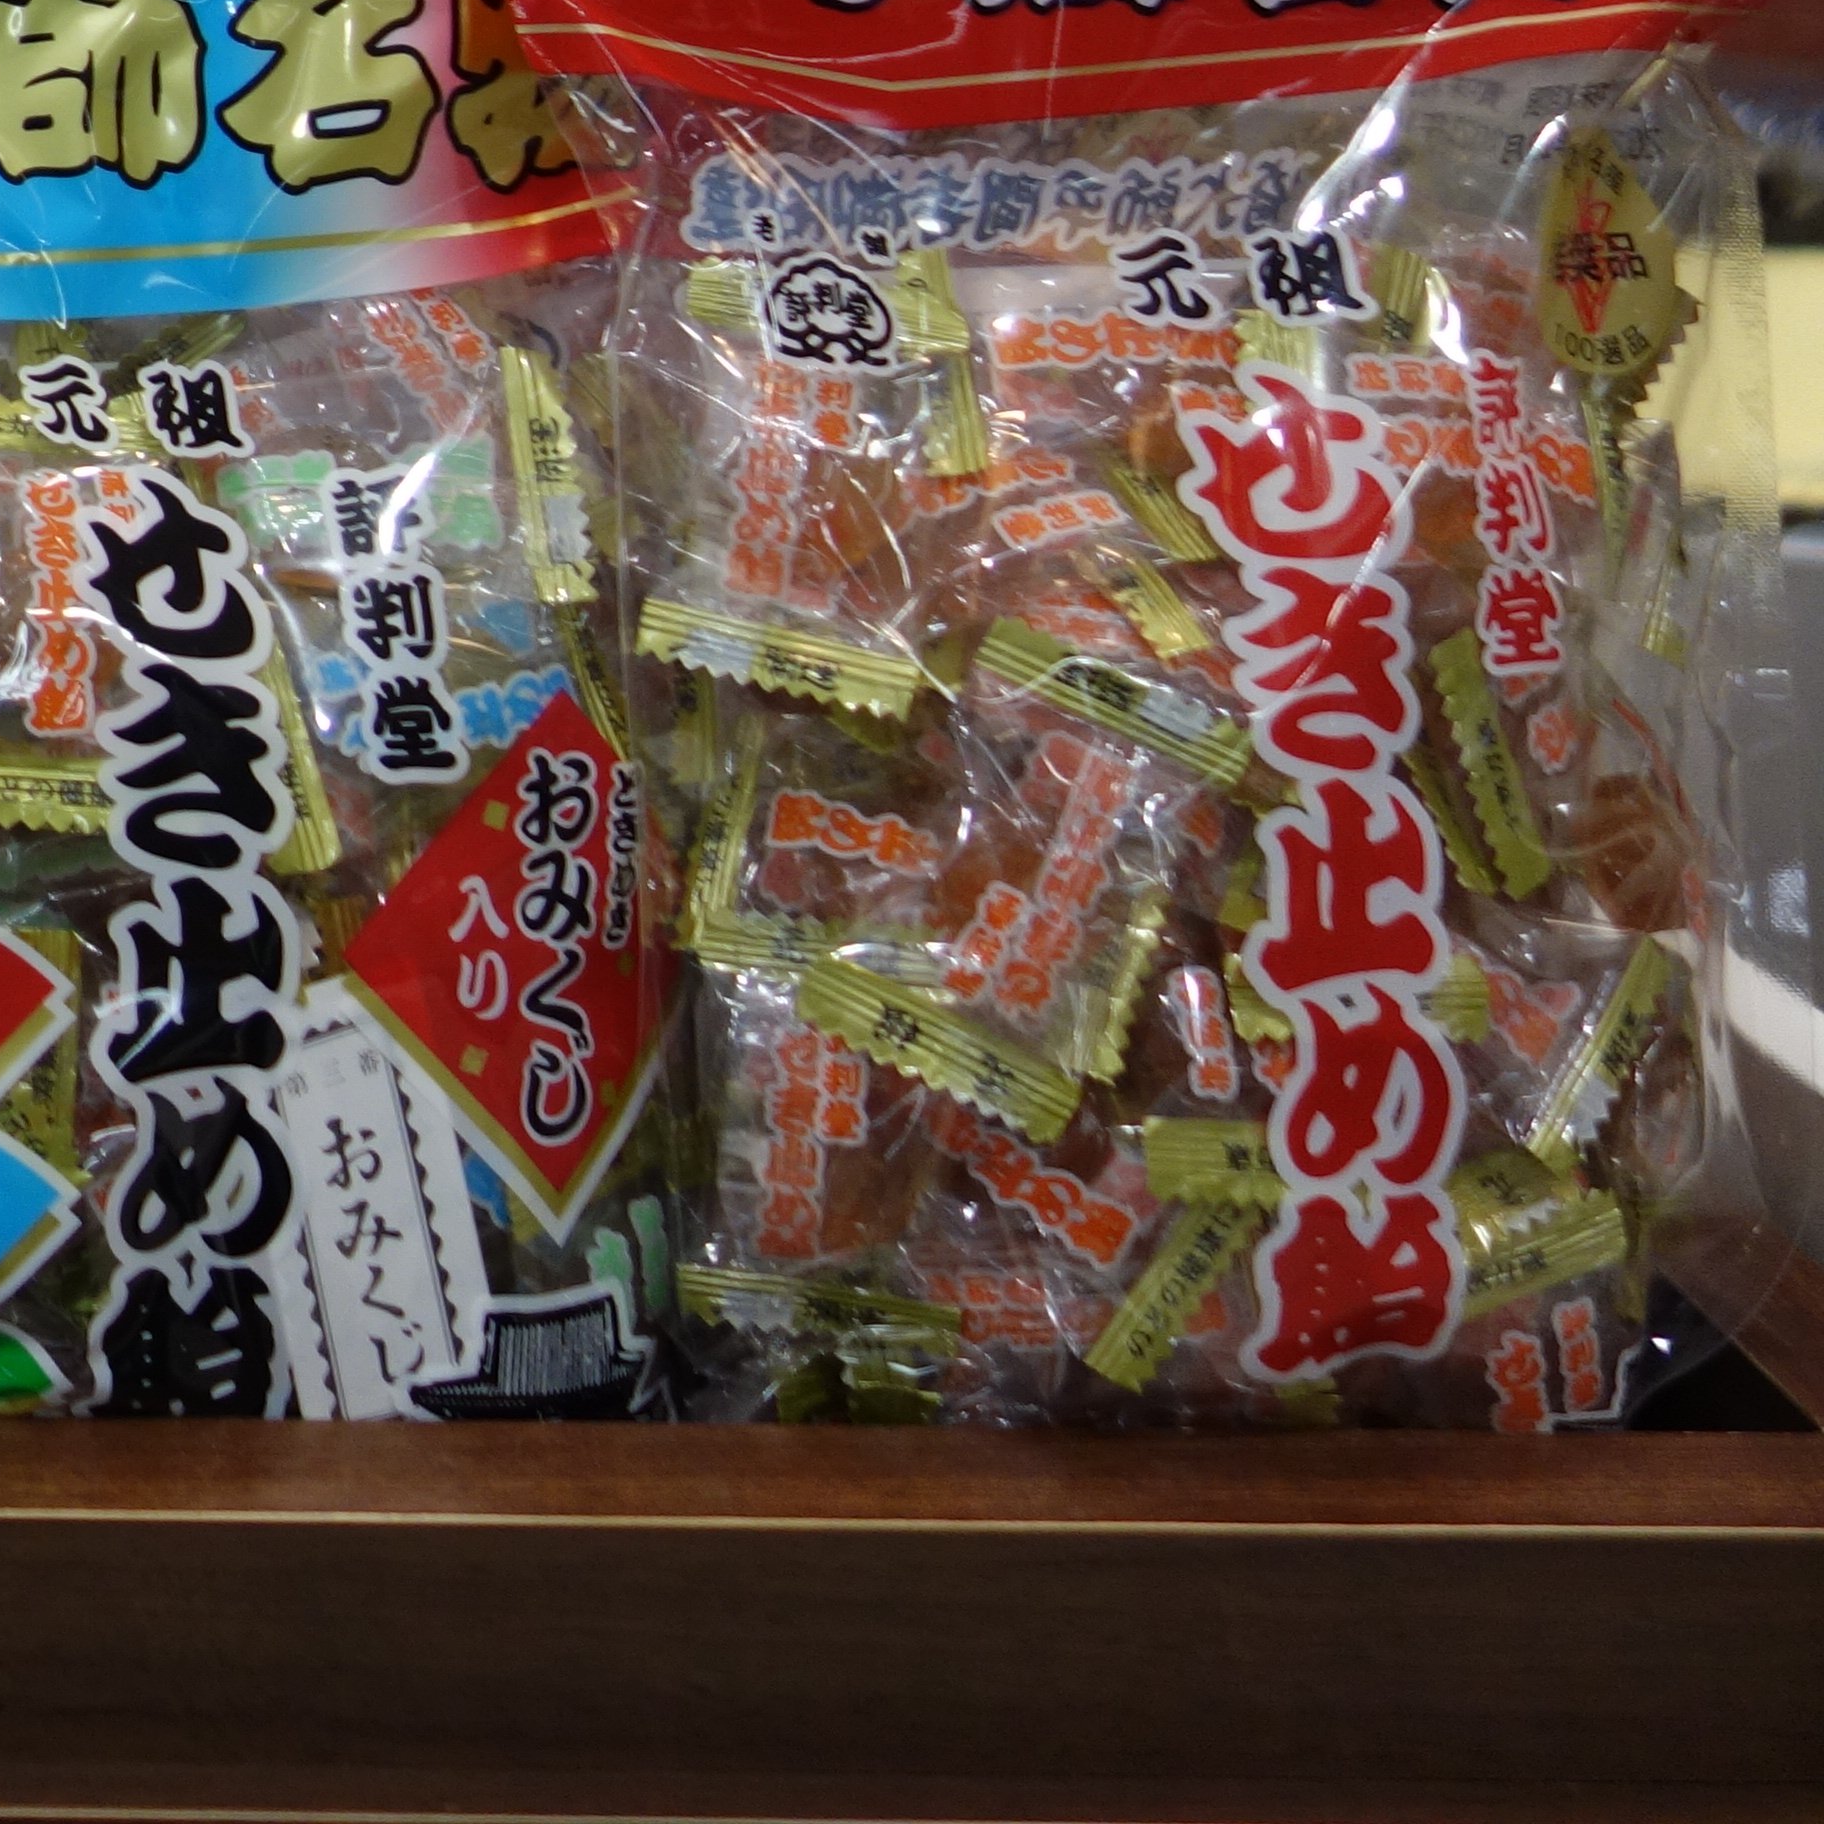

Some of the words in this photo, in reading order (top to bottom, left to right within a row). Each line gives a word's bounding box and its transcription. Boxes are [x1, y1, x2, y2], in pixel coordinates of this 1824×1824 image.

[25, 363, 244, 449] 元祖
[1118, 235, 1366, 322] 元祖
[334, 477, 456, 770] 評判堂
[1470, 356, 1561, 666] 評判堂
[91, 478, 289, 1420] せき止め飴
[447, 874, 510, 1020] 入り
[520, 753, 594, 1140] おみくじ
[1194, 374, 1456, 1368] せき止め飴
[321, 1117, 426, 1384] おみくじ
